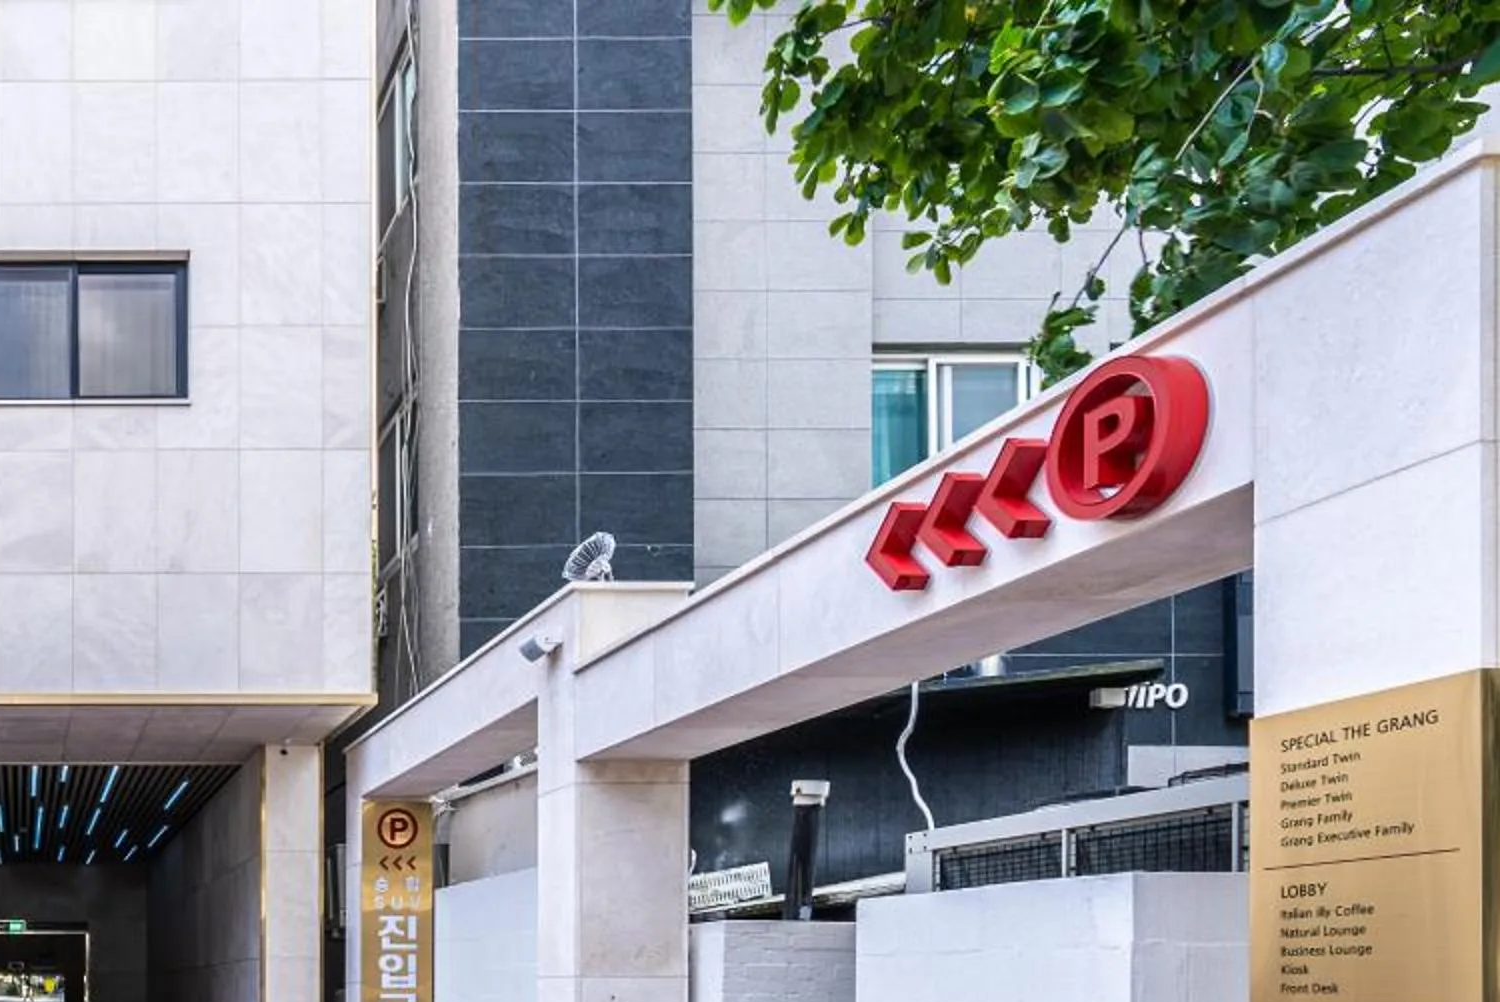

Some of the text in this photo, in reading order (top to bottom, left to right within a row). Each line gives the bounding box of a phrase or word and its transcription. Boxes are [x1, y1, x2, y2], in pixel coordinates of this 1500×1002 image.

[1281, 709, 1440, 752] SPECIAL THE GRANG
[1281, 751, 1361, 774] Standard Twin
[1281, 771, 1349, 792] Deluxe Twin
[1281, 791, 1353, 810] Premier Twin
[1281, 809, 1353, 829] Grang Family
[1281, 821, 1415, 848] Grang Executive Family
[1281, 882, 1328, 899] LOBBY
[1335, 903, 1375, 917] Coffee
[1281, 925, 1367, 939] Natural Lounge
[1281, 944, 1373, 957] Business Lounge
[1281, 964, 1309, 975] Kiosk
[1281, 982, 1338, 995] Front Desk
